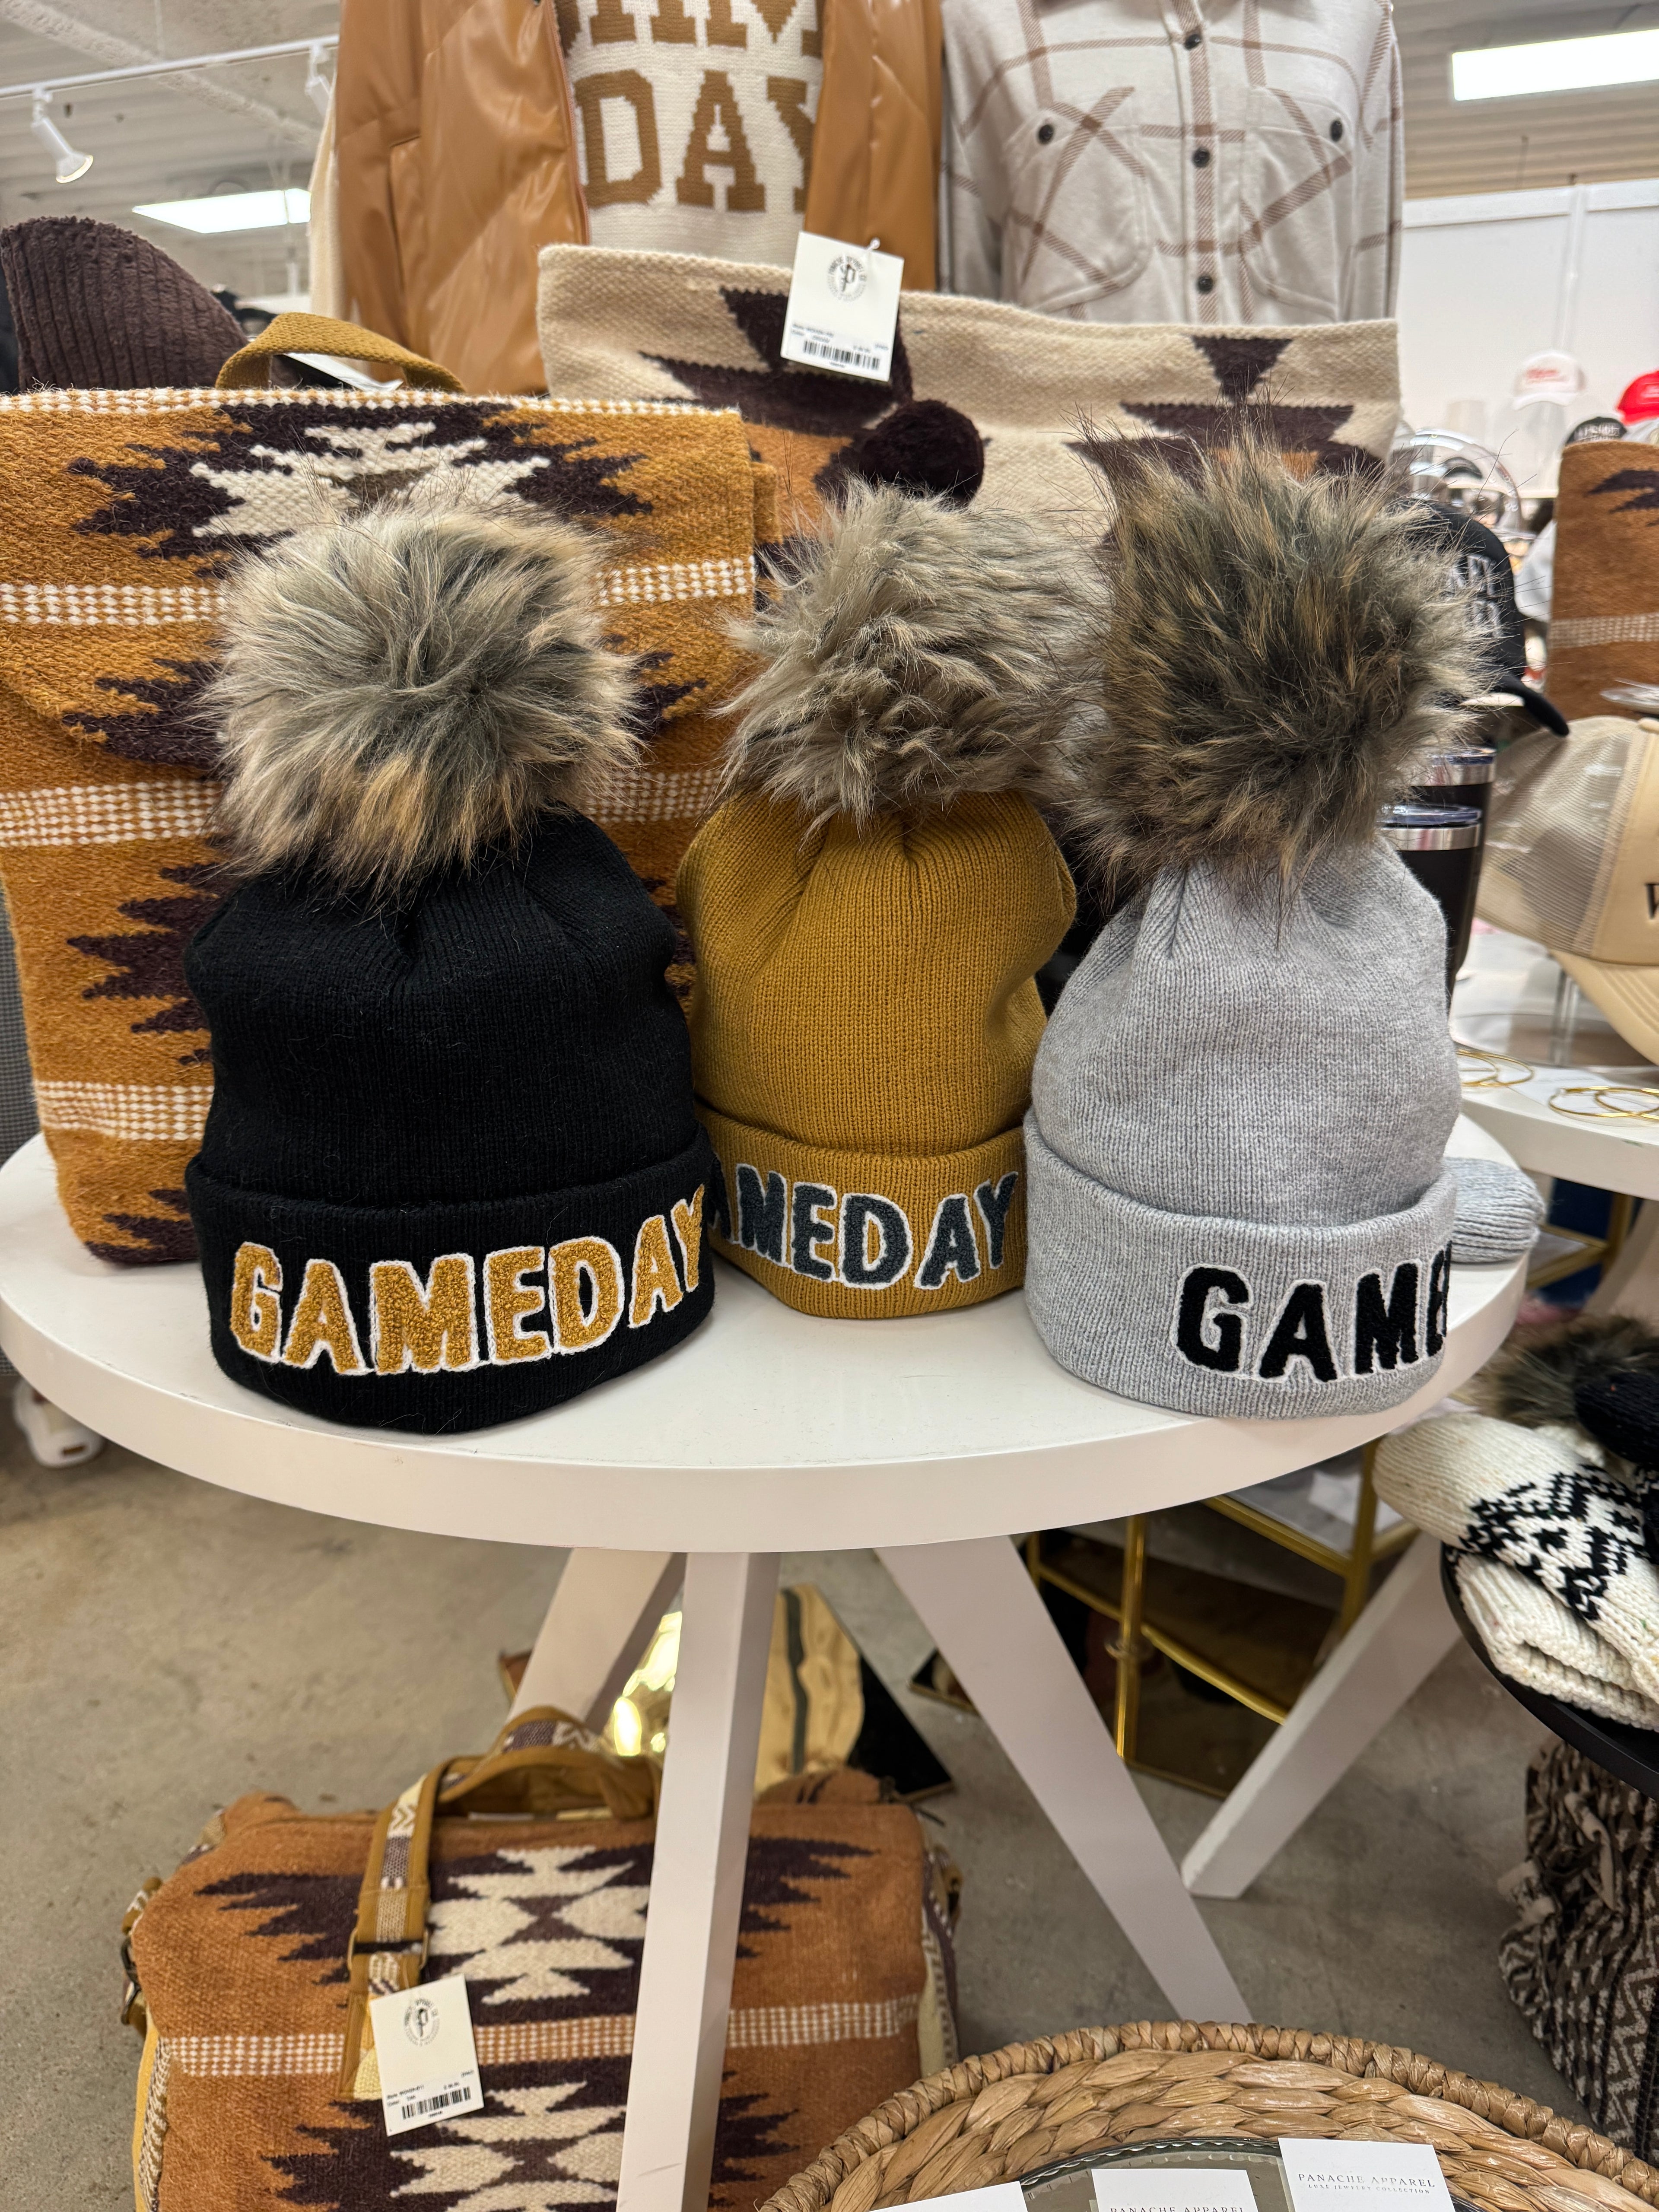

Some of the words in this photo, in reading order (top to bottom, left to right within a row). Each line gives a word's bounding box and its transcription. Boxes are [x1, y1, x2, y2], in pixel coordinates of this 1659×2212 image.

[230, 1185, 705, 1376] GAMEDAY
[1298, 2174, 1364, 2183] PANACHE
[1371, 2177, 1435, 2187] APPAREL
